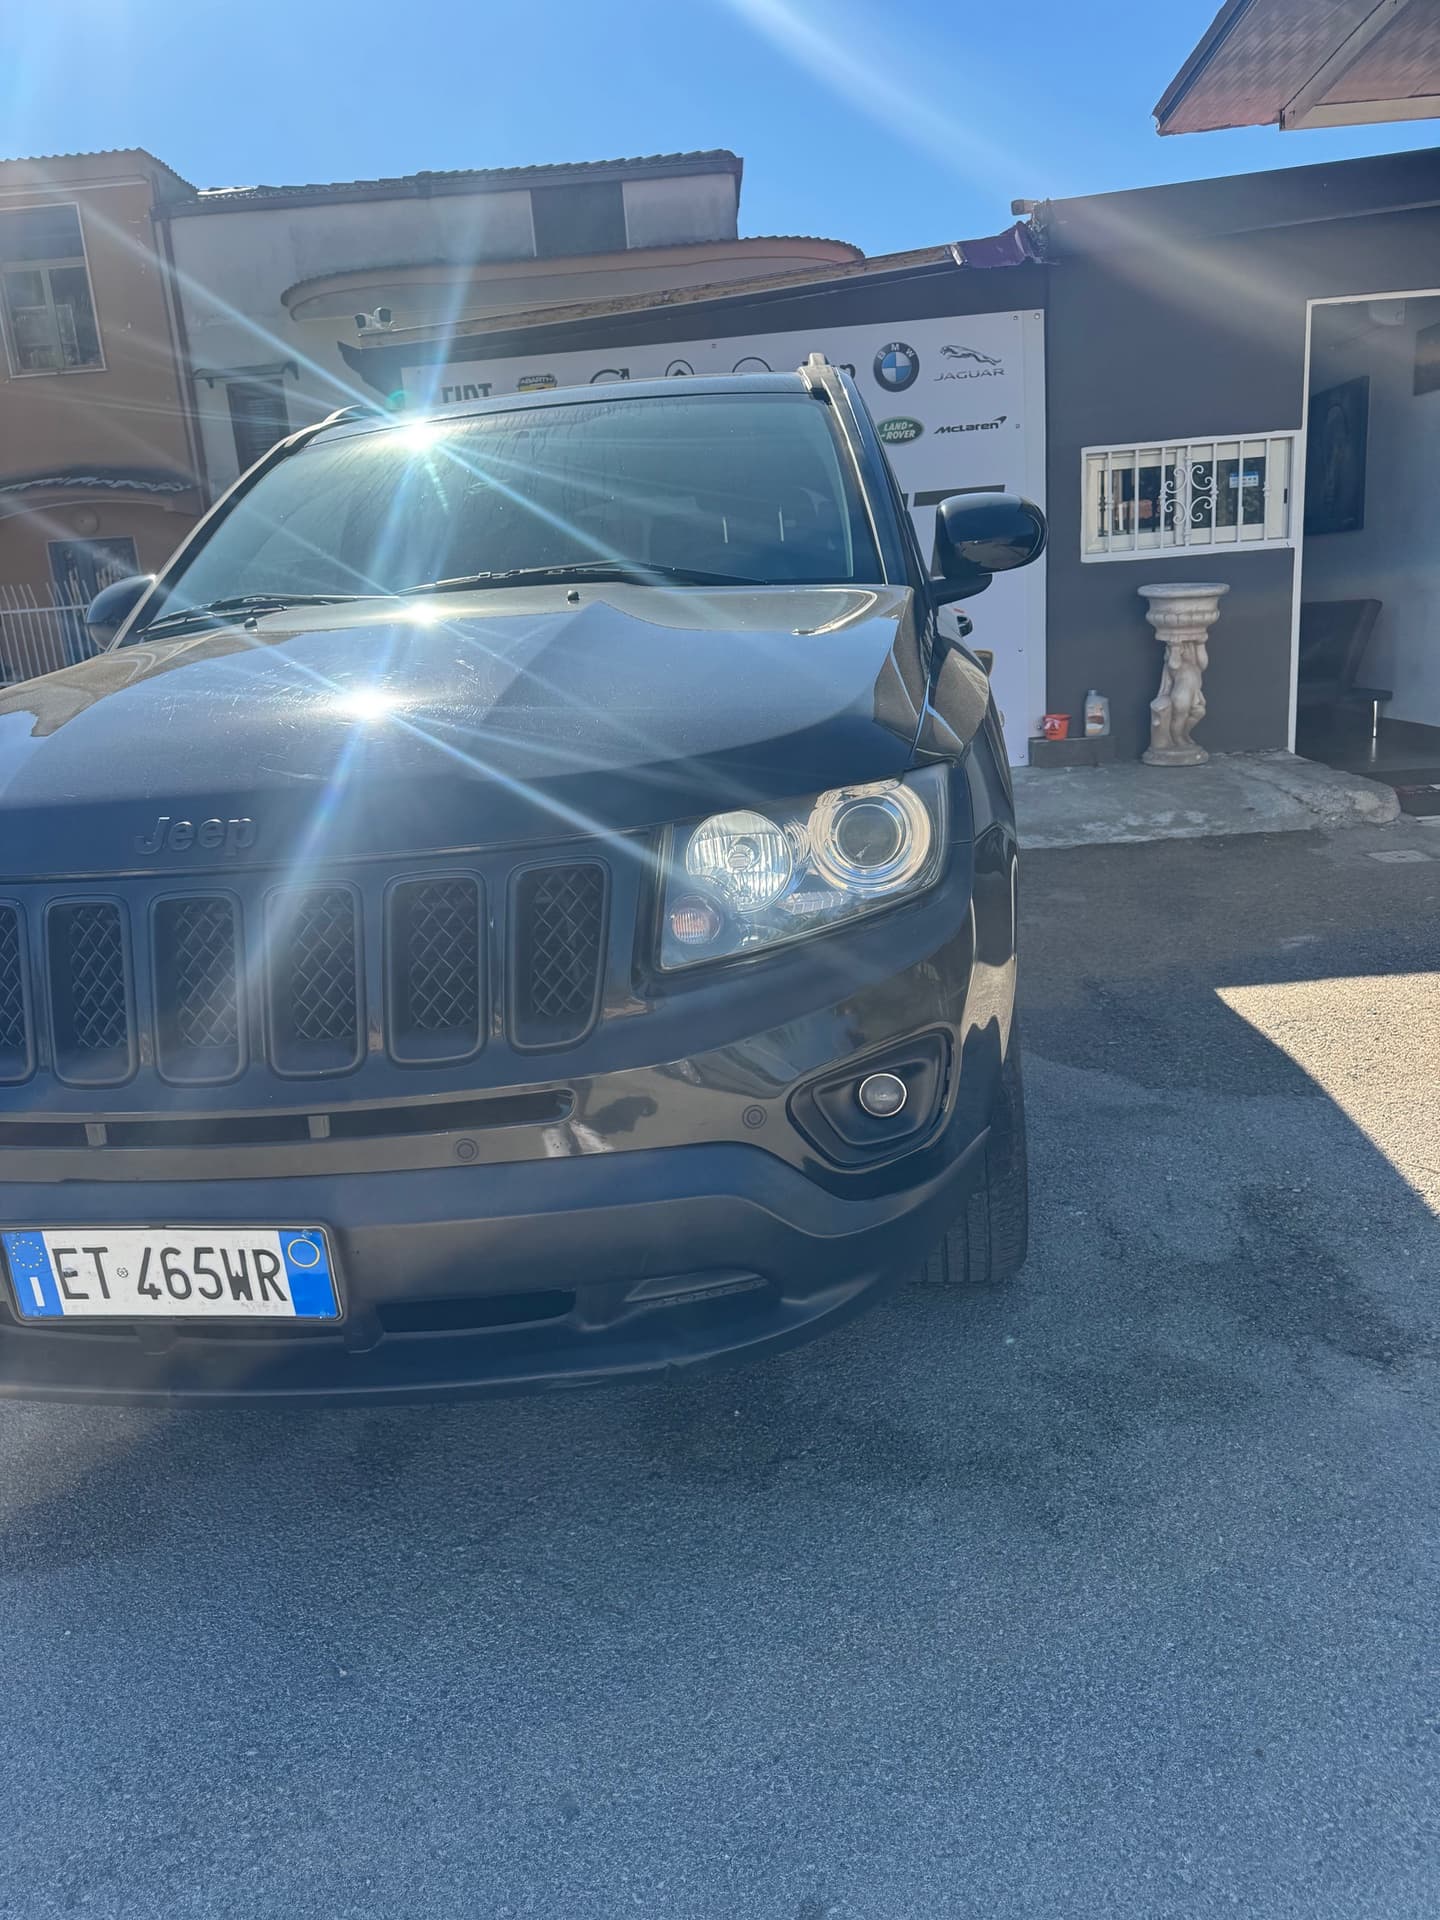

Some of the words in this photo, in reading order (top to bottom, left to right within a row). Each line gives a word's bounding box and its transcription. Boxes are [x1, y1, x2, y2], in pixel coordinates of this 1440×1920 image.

[877, 343, 916, 360] BMW
[933, 368, 1005, 381] JAGUAR
[933, 421, 1000, 434] McLaren
[134, 816, 257, 857] Jeep
[52, 1246, 111, 1300] ET
[137, 1247, 288, 1302] 465WR
